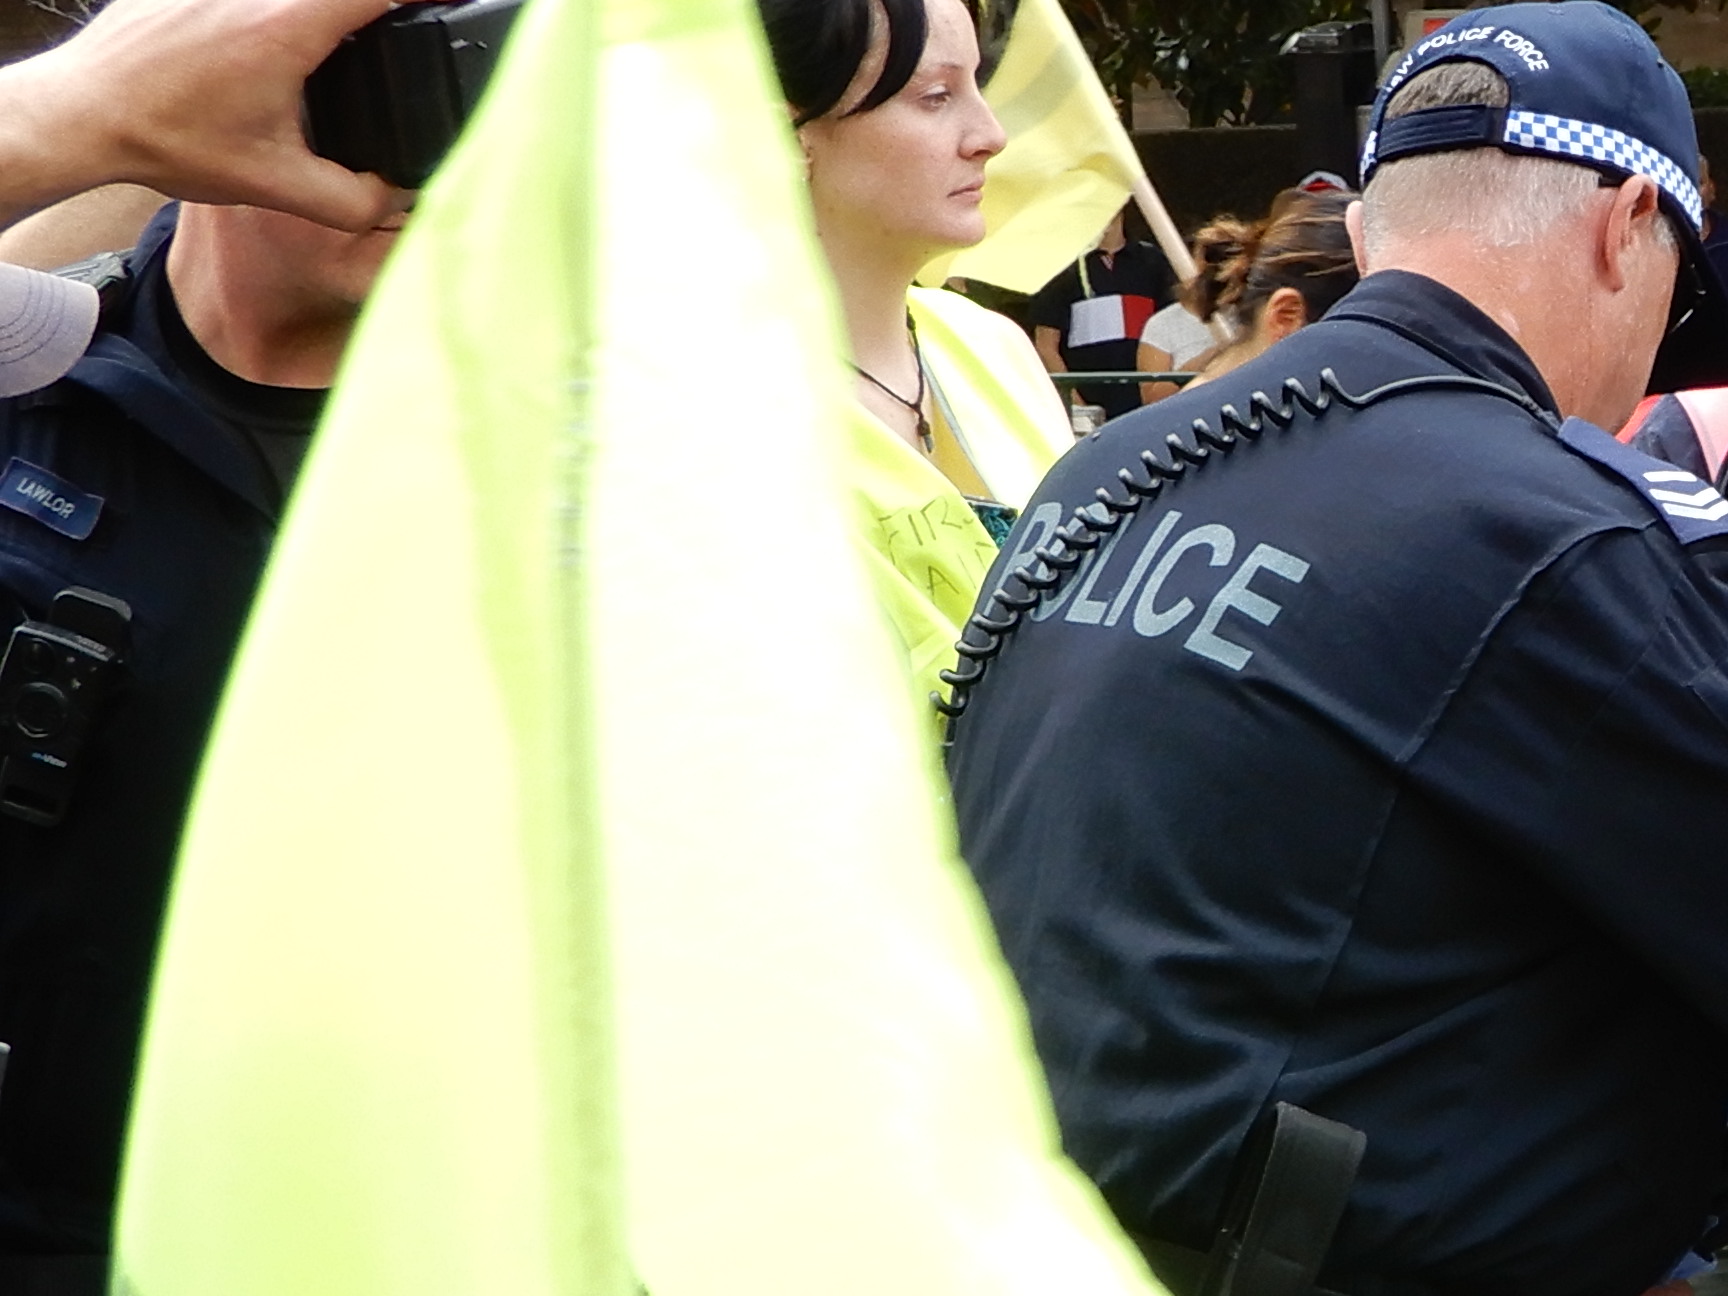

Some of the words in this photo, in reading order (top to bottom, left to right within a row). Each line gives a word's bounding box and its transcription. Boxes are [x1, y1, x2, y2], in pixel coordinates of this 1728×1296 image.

[1417, 26, 1496, 56] POLICE
[1493, 30, 1550, 72] FORCE
[16, 477, 76, 519] LAWLOR
[983, 502, 1311, 672] POLICE
